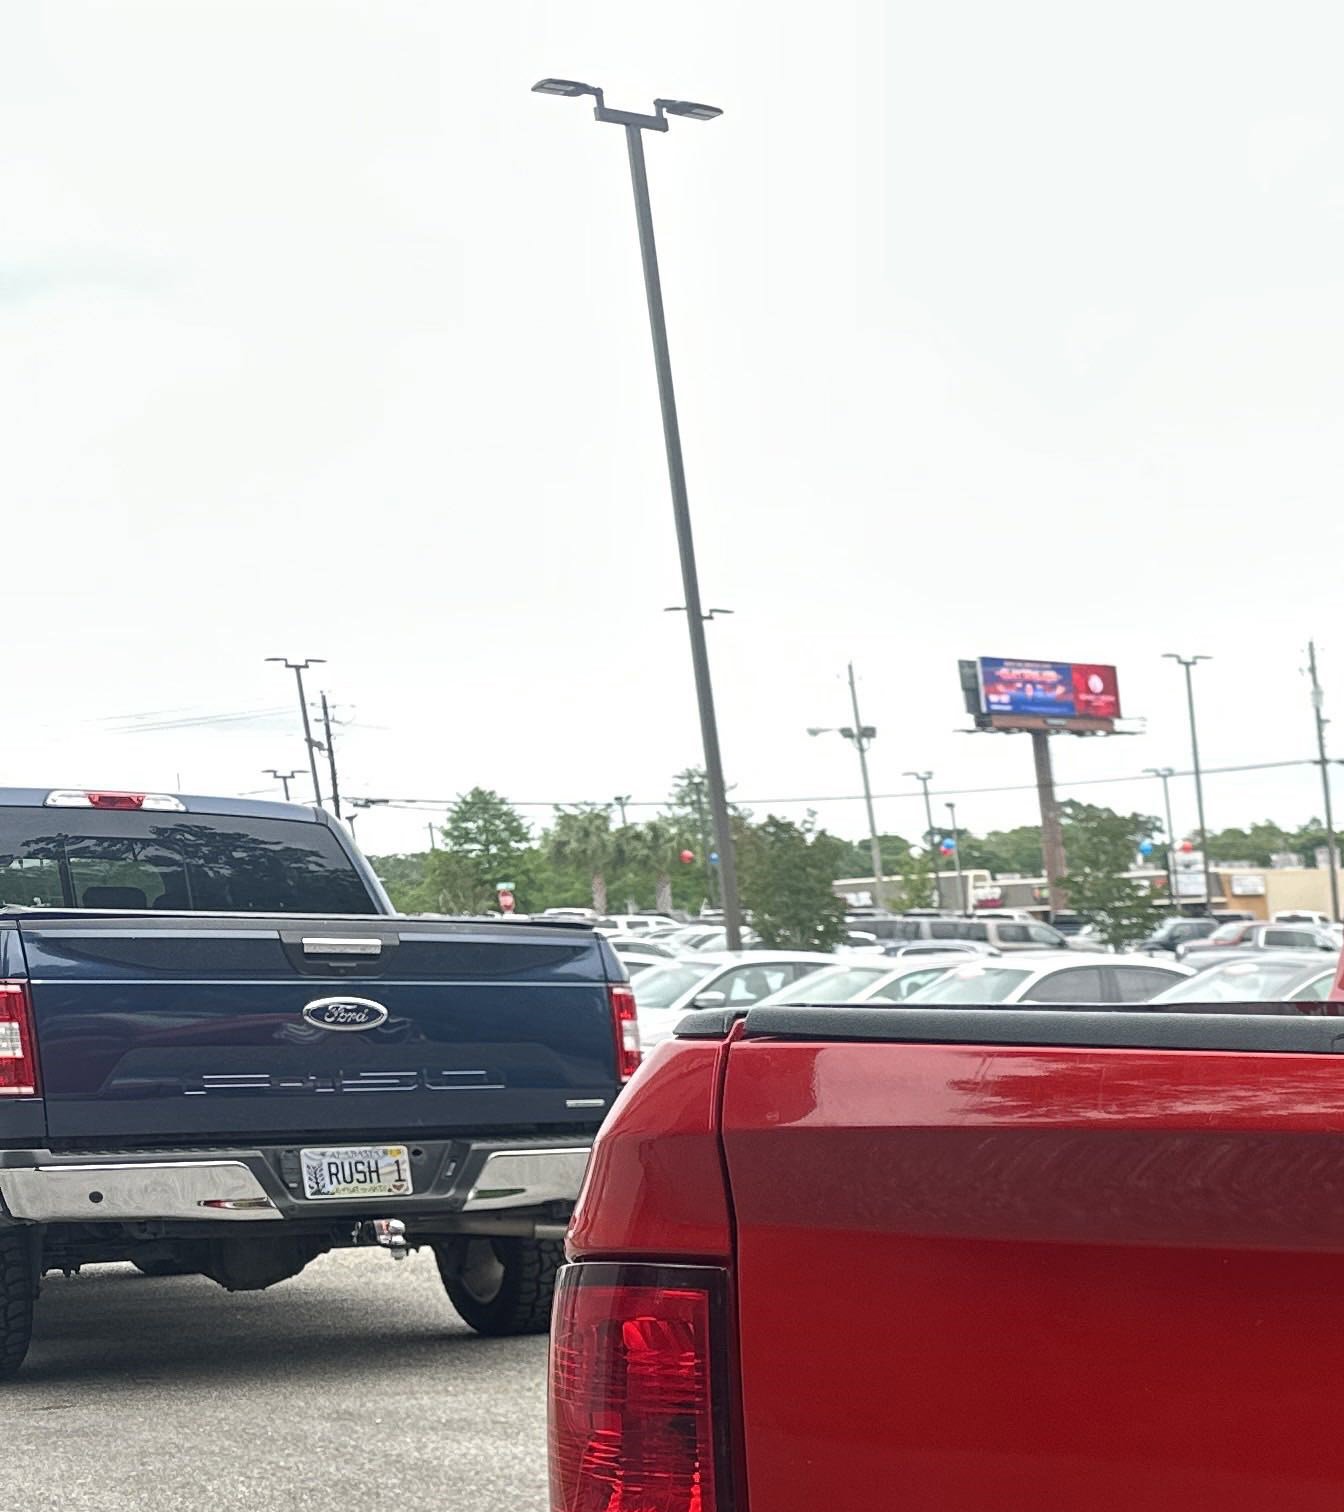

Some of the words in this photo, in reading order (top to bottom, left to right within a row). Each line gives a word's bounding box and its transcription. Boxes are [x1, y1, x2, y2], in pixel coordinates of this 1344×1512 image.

[324, 1003, 369, 1023] Ford
[327, 1159, 381, 1186] RUSH
[394, 1159, 406, 1182] 1
